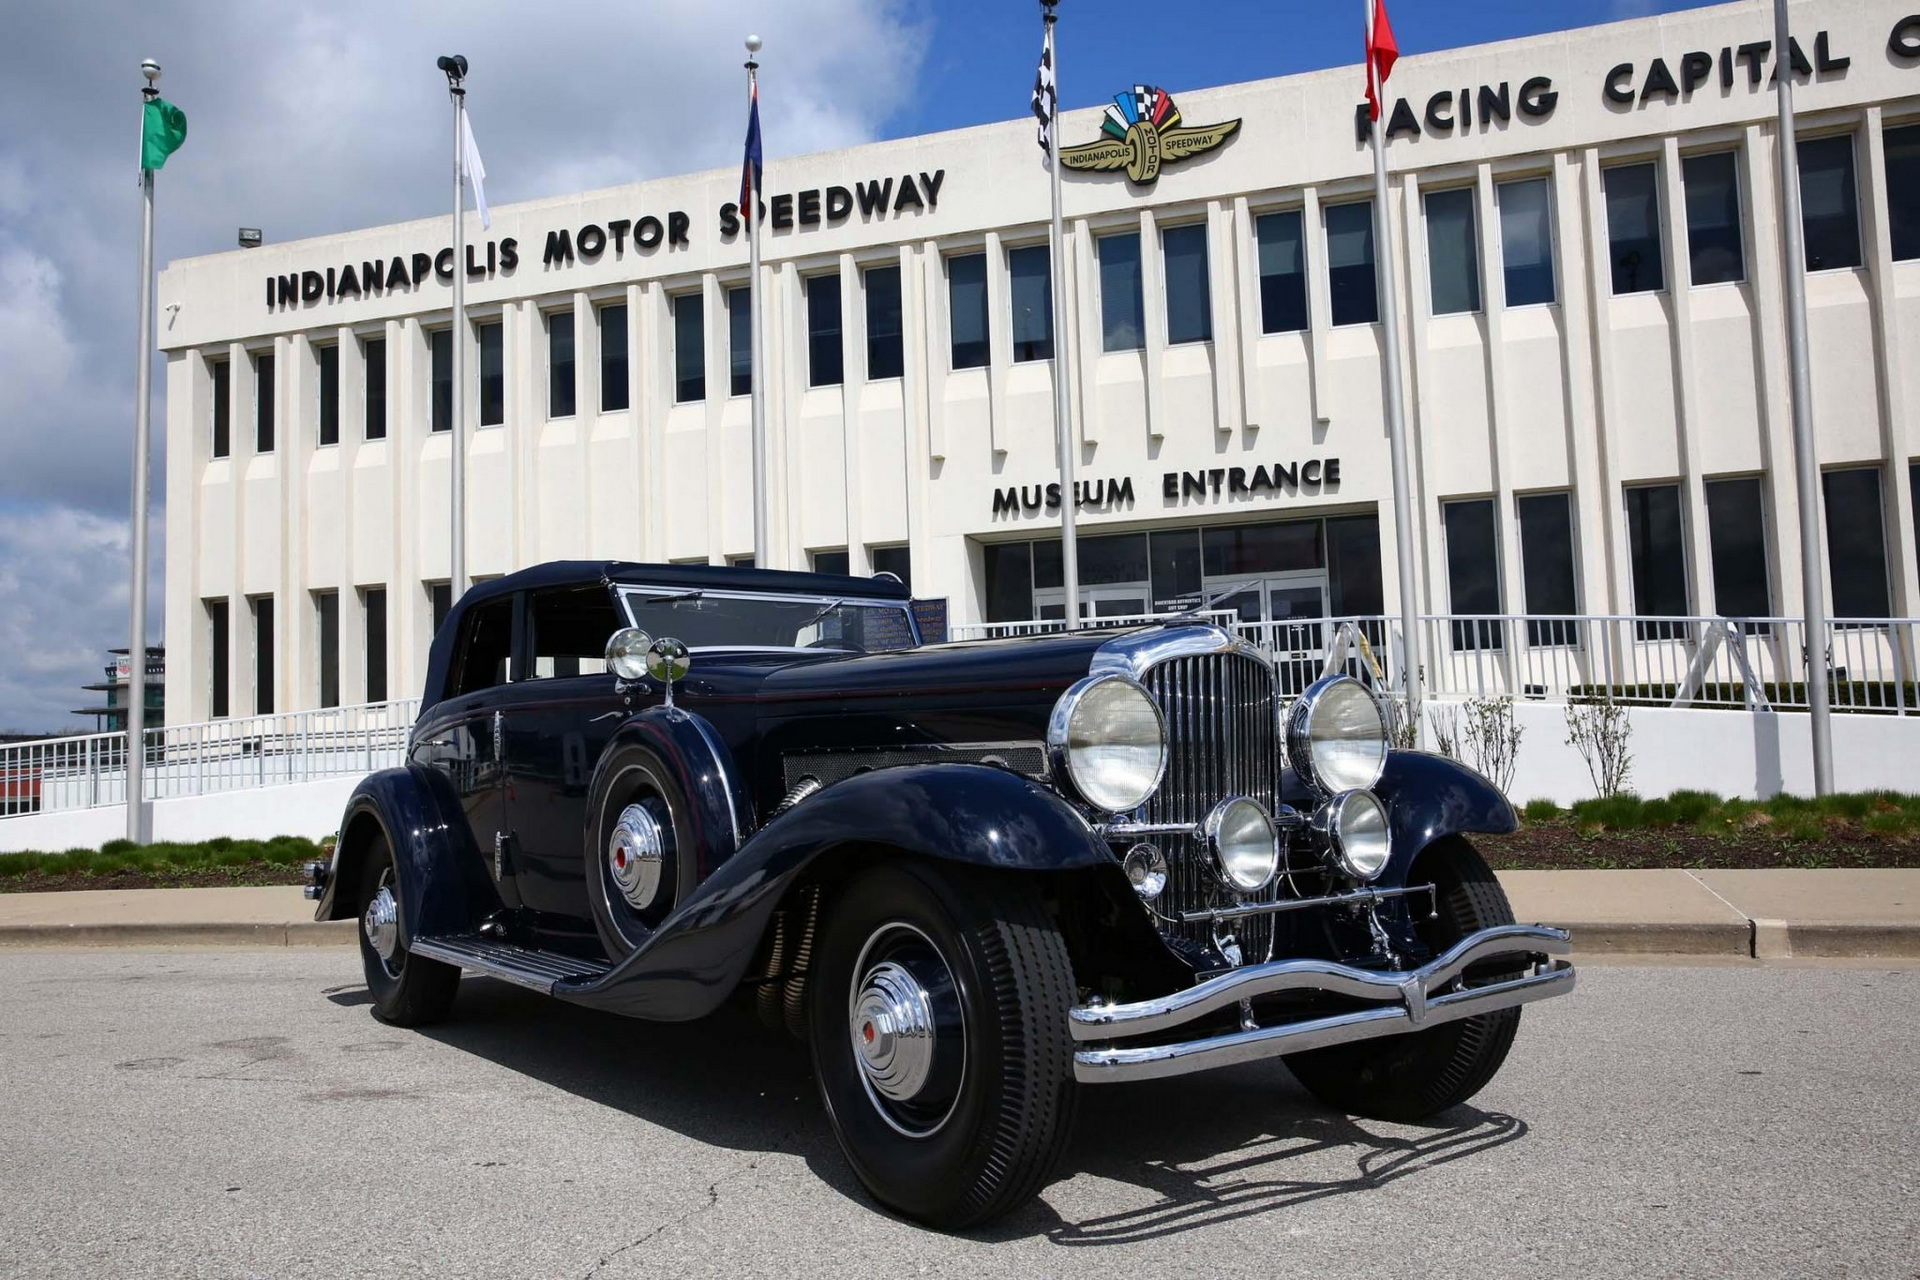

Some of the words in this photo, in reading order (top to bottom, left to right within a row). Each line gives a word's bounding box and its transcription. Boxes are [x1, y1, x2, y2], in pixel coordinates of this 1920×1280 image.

[1603, 30, 1851, 101] CAPITAL
[1069, 147, 1131, 165] INDIANAPOLIS
[1143, 127, 1158, 174] MOTOR
[1165, 135, 1214, 151] SPEEDWAY
[266, 237, 519, 307] INDIANAPOLIS
[543, 210, 690, 264] MOTOR
[1163, 458, 1341, 499] ENTRANCE
